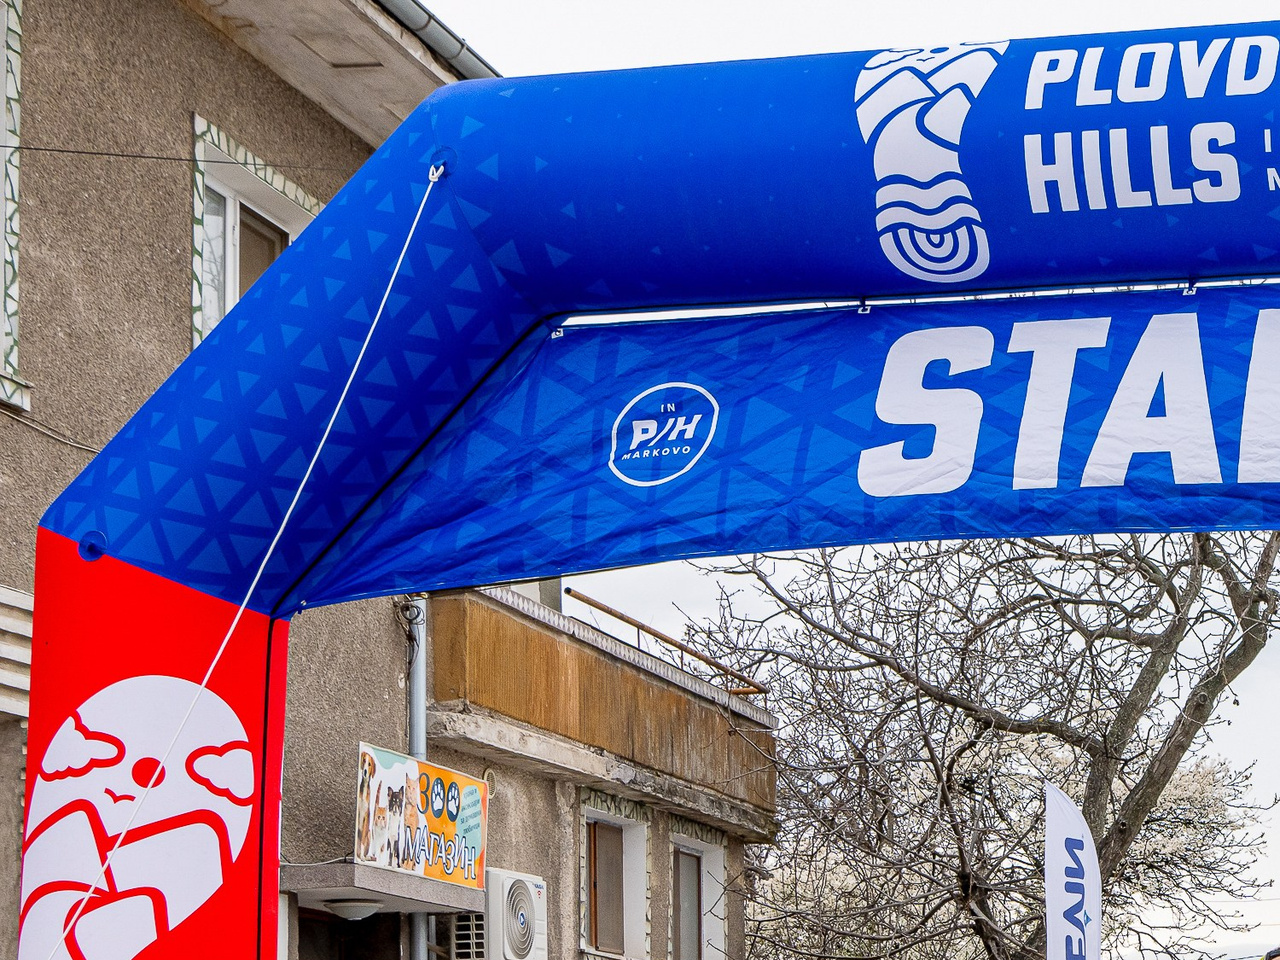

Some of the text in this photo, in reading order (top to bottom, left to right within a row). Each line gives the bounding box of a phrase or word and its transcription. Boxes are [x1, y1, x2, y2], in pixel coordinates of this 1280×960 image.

[1023, 121, 1242, 214] HILLS
[660, 402, 676, 413] IN
[629, 414, 703, 450] P/H
[621, 446, 691, 460] MARKOVO
[404, 824, 477, 880] МАГАЗИН
